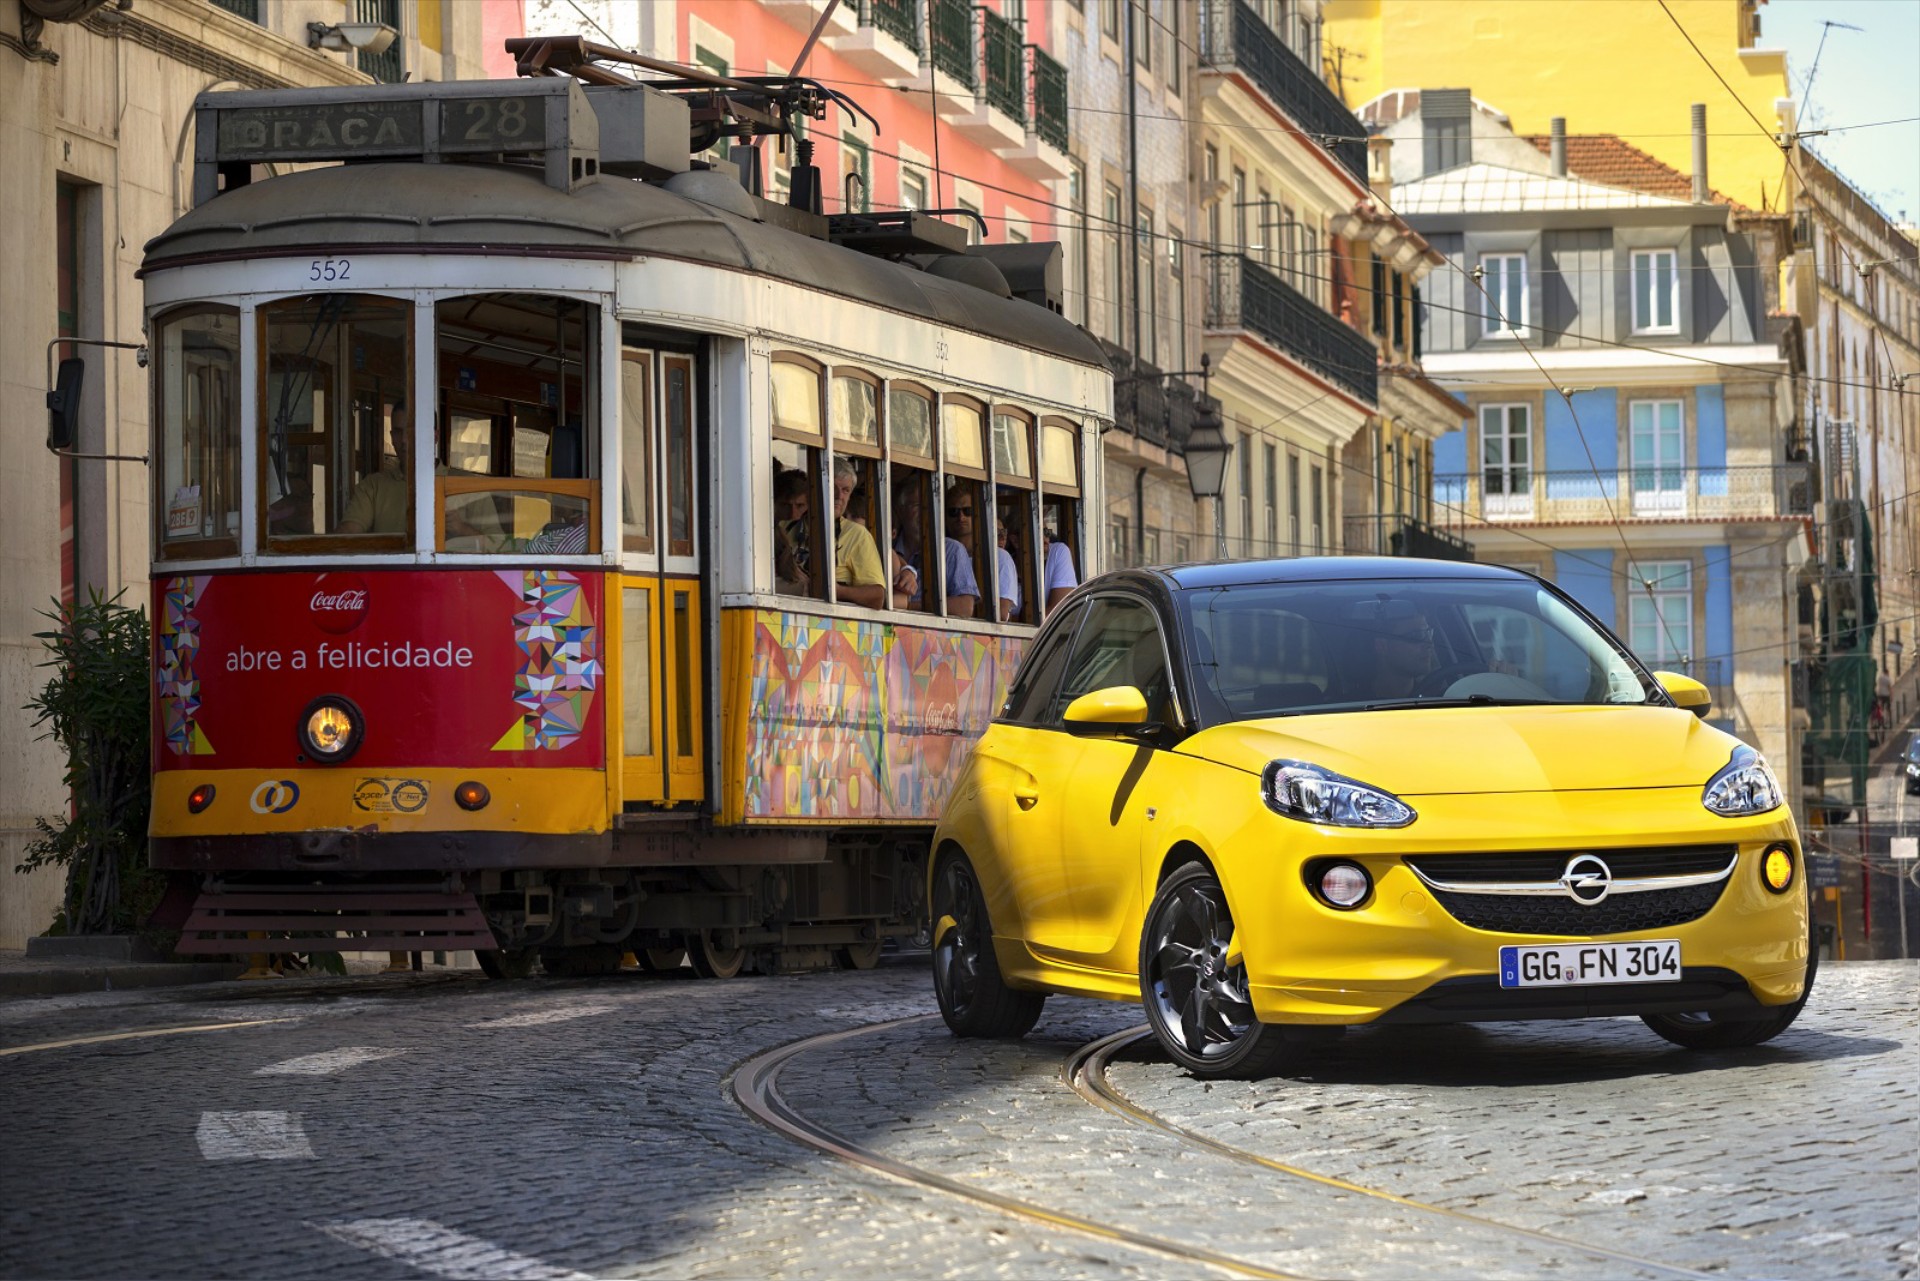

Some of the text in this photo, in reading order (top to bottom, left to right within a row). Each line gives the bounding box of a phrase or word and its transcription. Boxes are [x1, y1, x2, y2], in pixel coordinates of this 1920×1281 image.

[464, 100, 527, 141] 28
[309, 259, 351, 281] 552
[935, 341, 949, 361] 552
[310, 590, 368, 611] Coca-Cola
[225, 641, 474, 672] abre a felicidade
[1506, 945, 1678, 981] D GG FN 304
